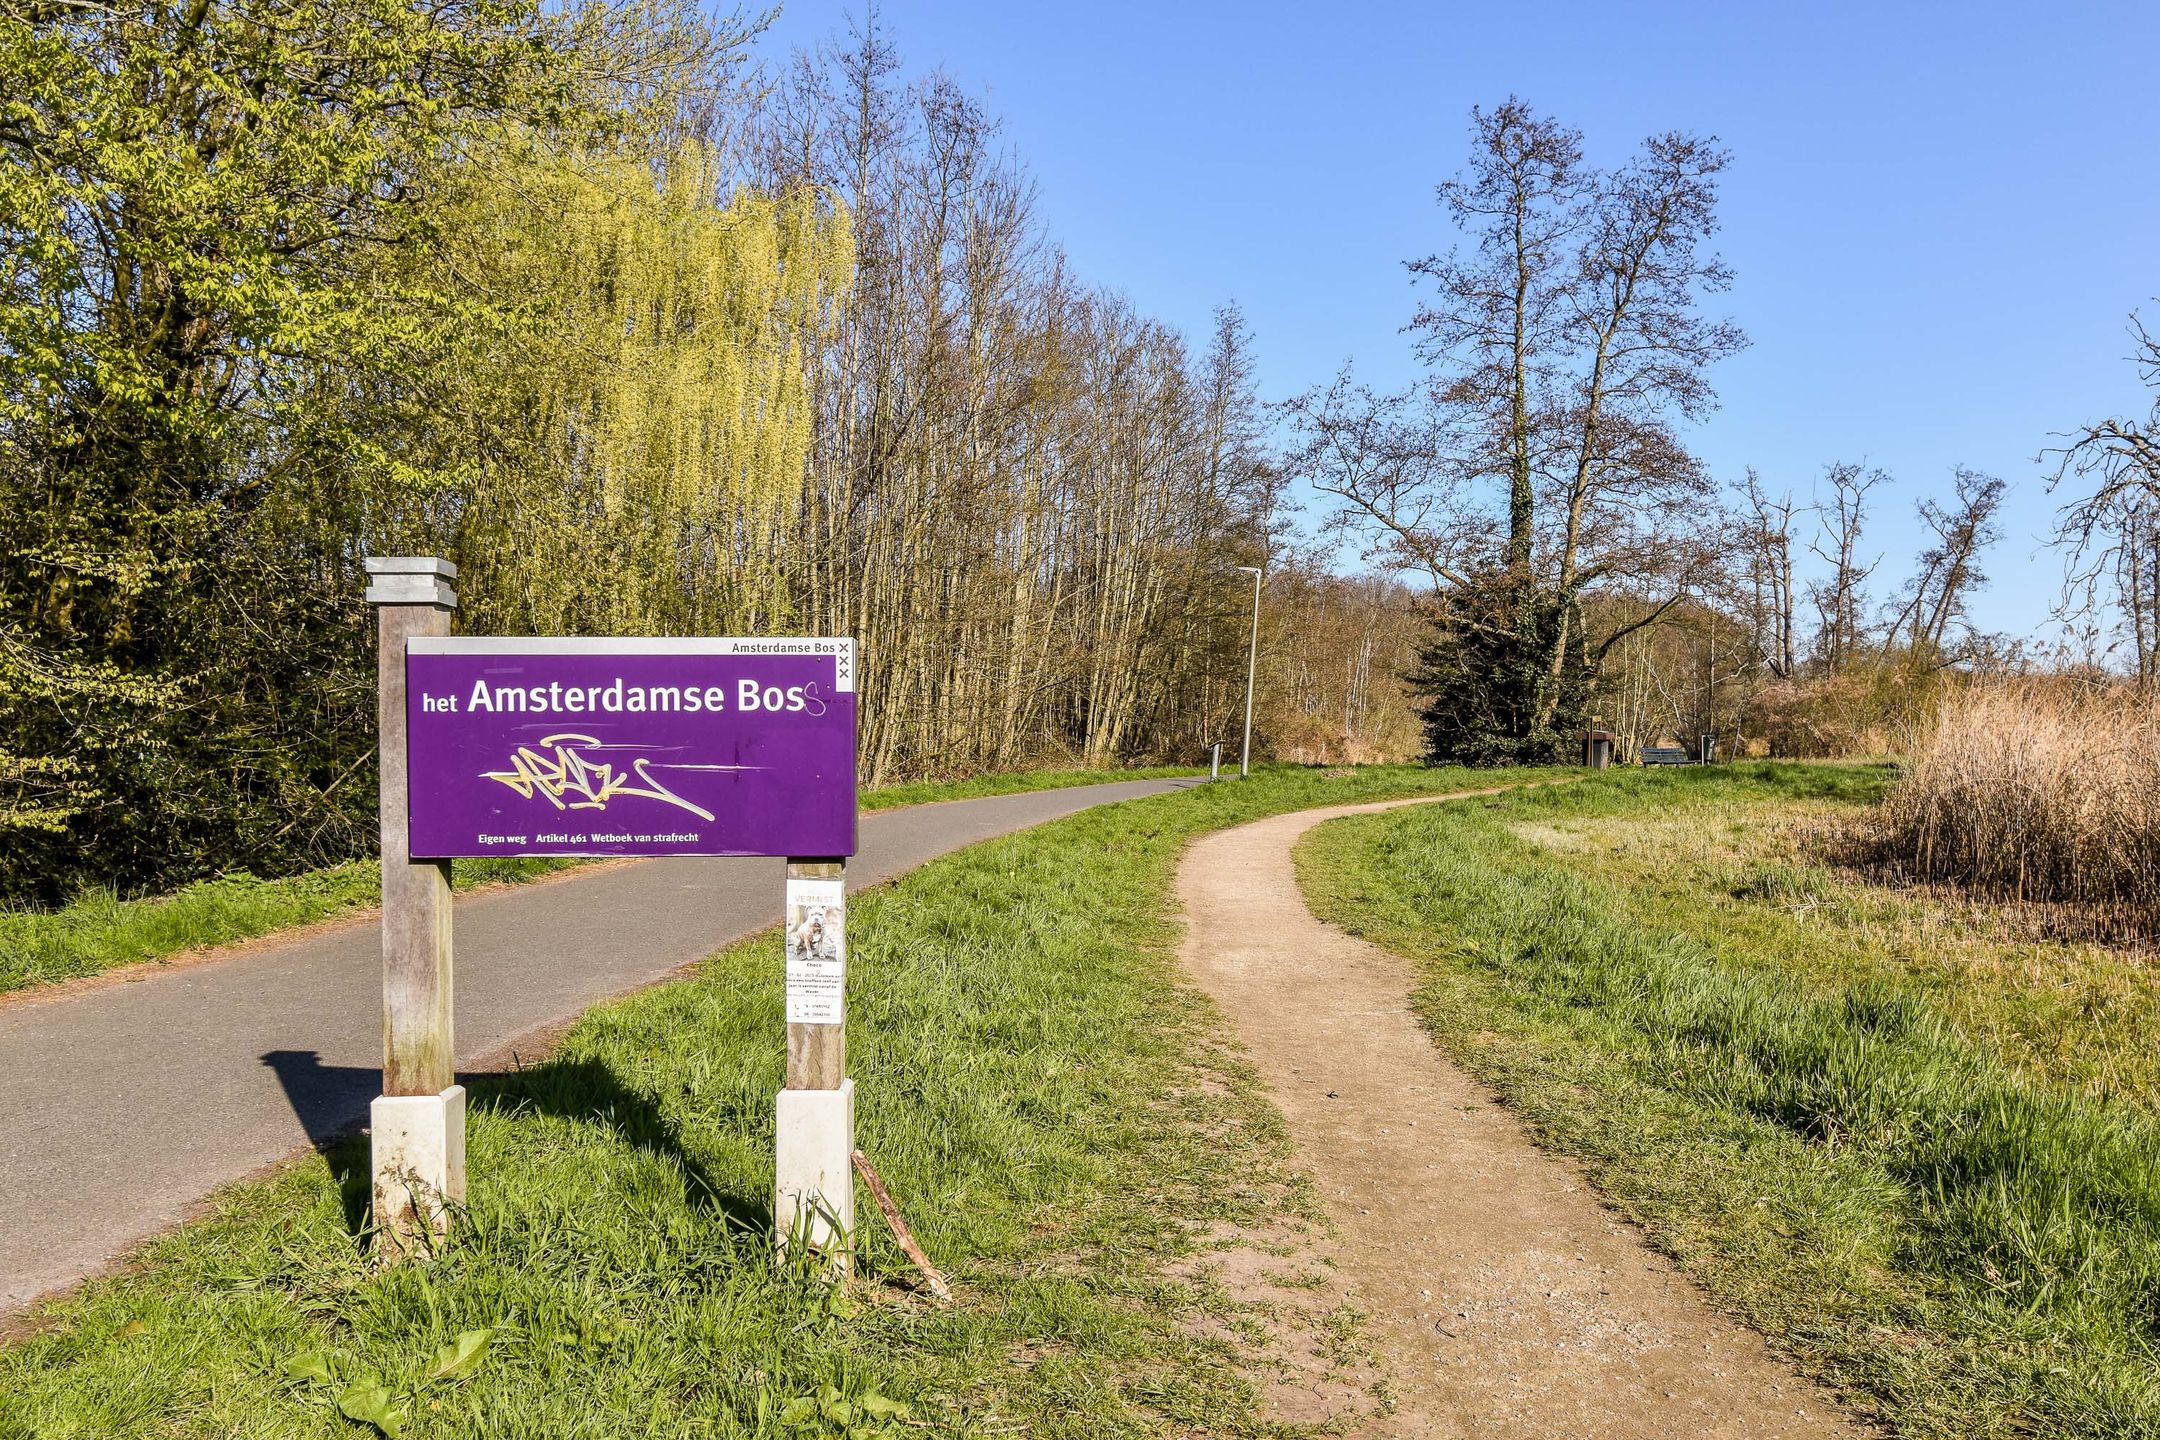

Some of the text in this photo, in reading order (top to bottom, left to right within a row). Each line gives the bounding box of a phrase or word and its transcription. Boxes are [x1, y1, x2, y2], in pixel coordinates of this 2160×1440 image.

[732, 643, 835, 653] Amsterdamse Bos
[422, 678, 805, 713] het Amsterdamse Bos
[478, 834, 505, 844] Eigen
[507, 835, 527, 845] weg
[535, 834, 568, 843] Artikel
[570, 834, 587, 844] 461
[591, 833, 633, 842] Wetboek
[653, 832, 699, 844] strafrecht
